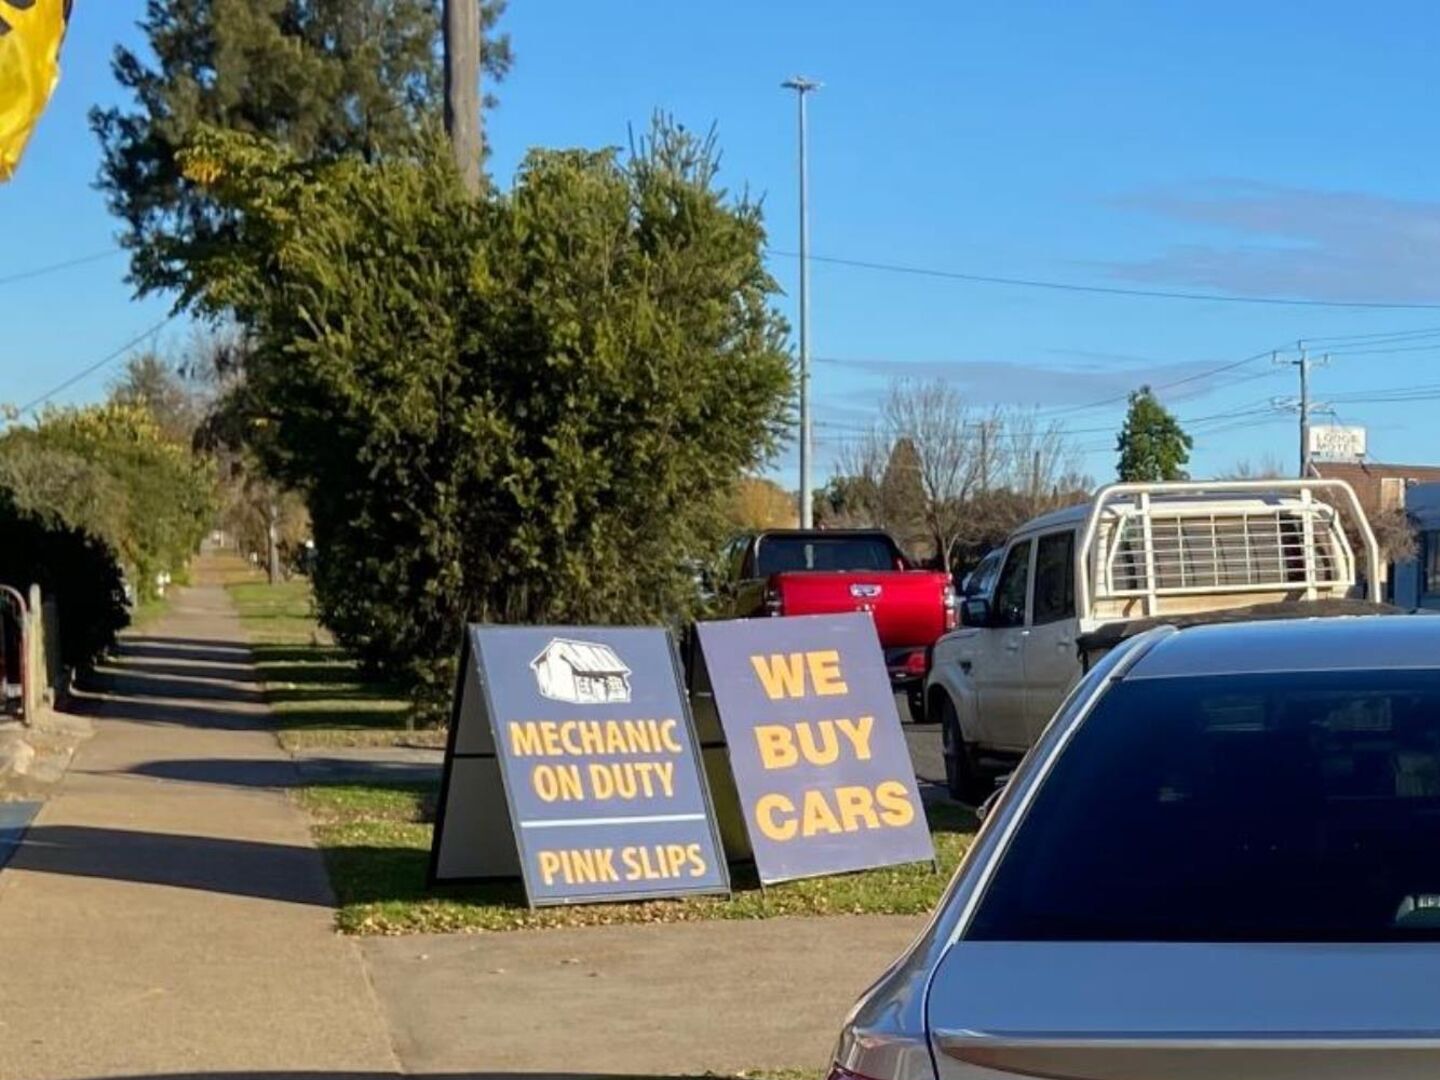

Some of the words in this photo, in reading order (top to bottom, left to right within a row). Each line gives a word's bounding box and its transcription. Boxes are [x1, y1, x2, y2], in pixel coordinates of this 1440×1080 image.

[751, 649, 849, 700] WE
[507, 718, 684, 758] MECHANIC
[754, 716, 875, 771] BUY
[533, 766, 585, 803] ON
[589, 760, 677, 800] DUTY
[756, 780, 915, 842] CARS
[538, 846, 620, 886] PINK
[622, 842, 708, 881] SLIPS
